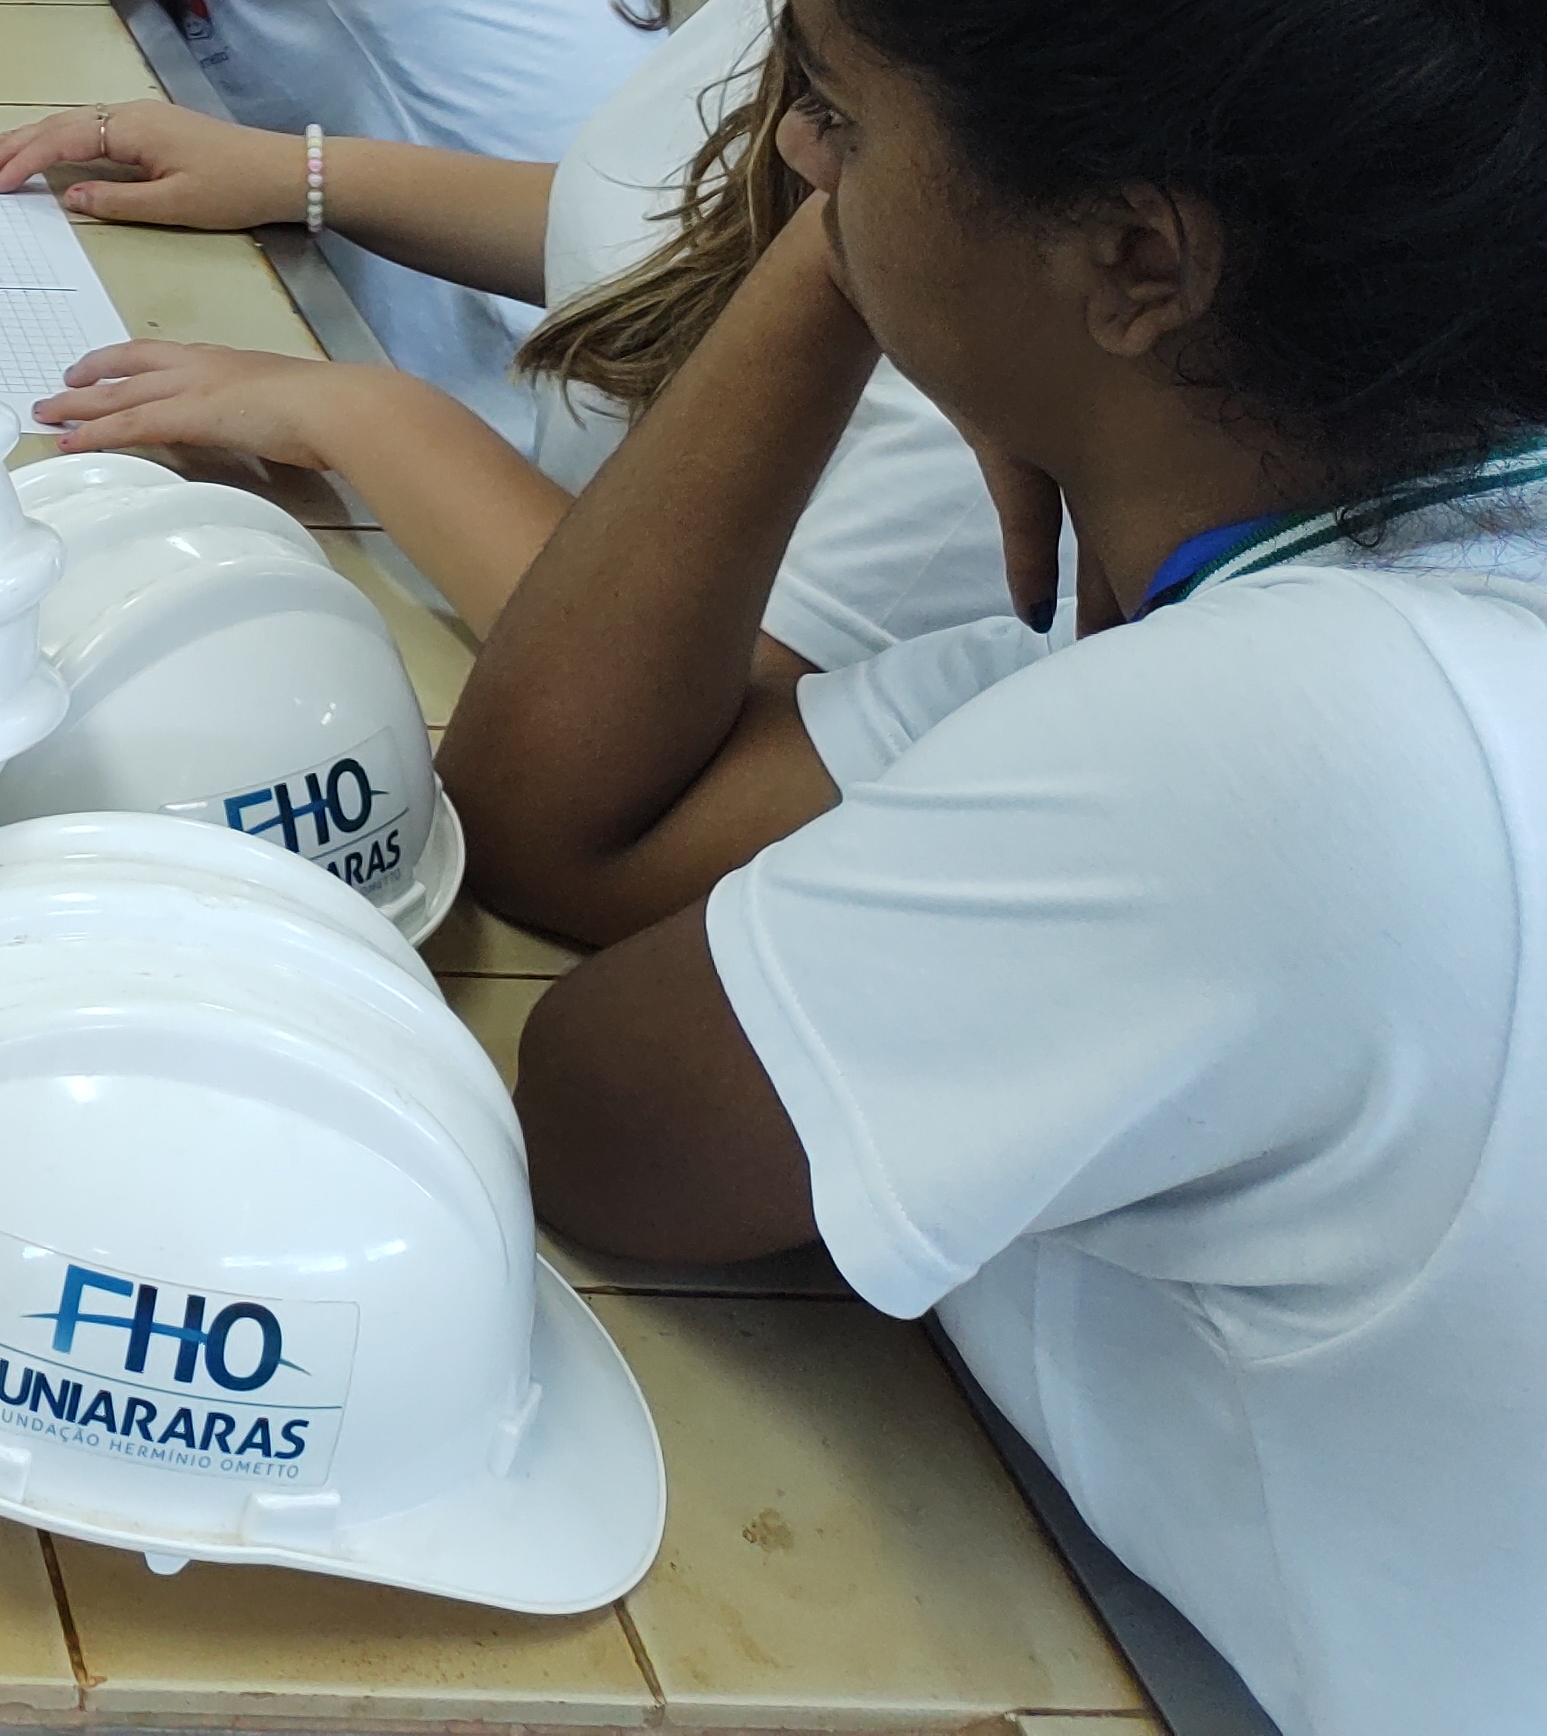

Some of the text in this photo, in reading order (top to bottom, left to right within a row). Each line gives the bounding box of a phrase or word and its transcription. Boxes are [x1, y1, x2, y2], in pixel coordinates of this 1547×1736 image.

[224, 758, 373, 853] FHO
[47, 1263, 285, 1392] FHO
[109, 1437, 212, 1469] HERMÍNIO
[219, 1459, 300, 1480] OMETTO
